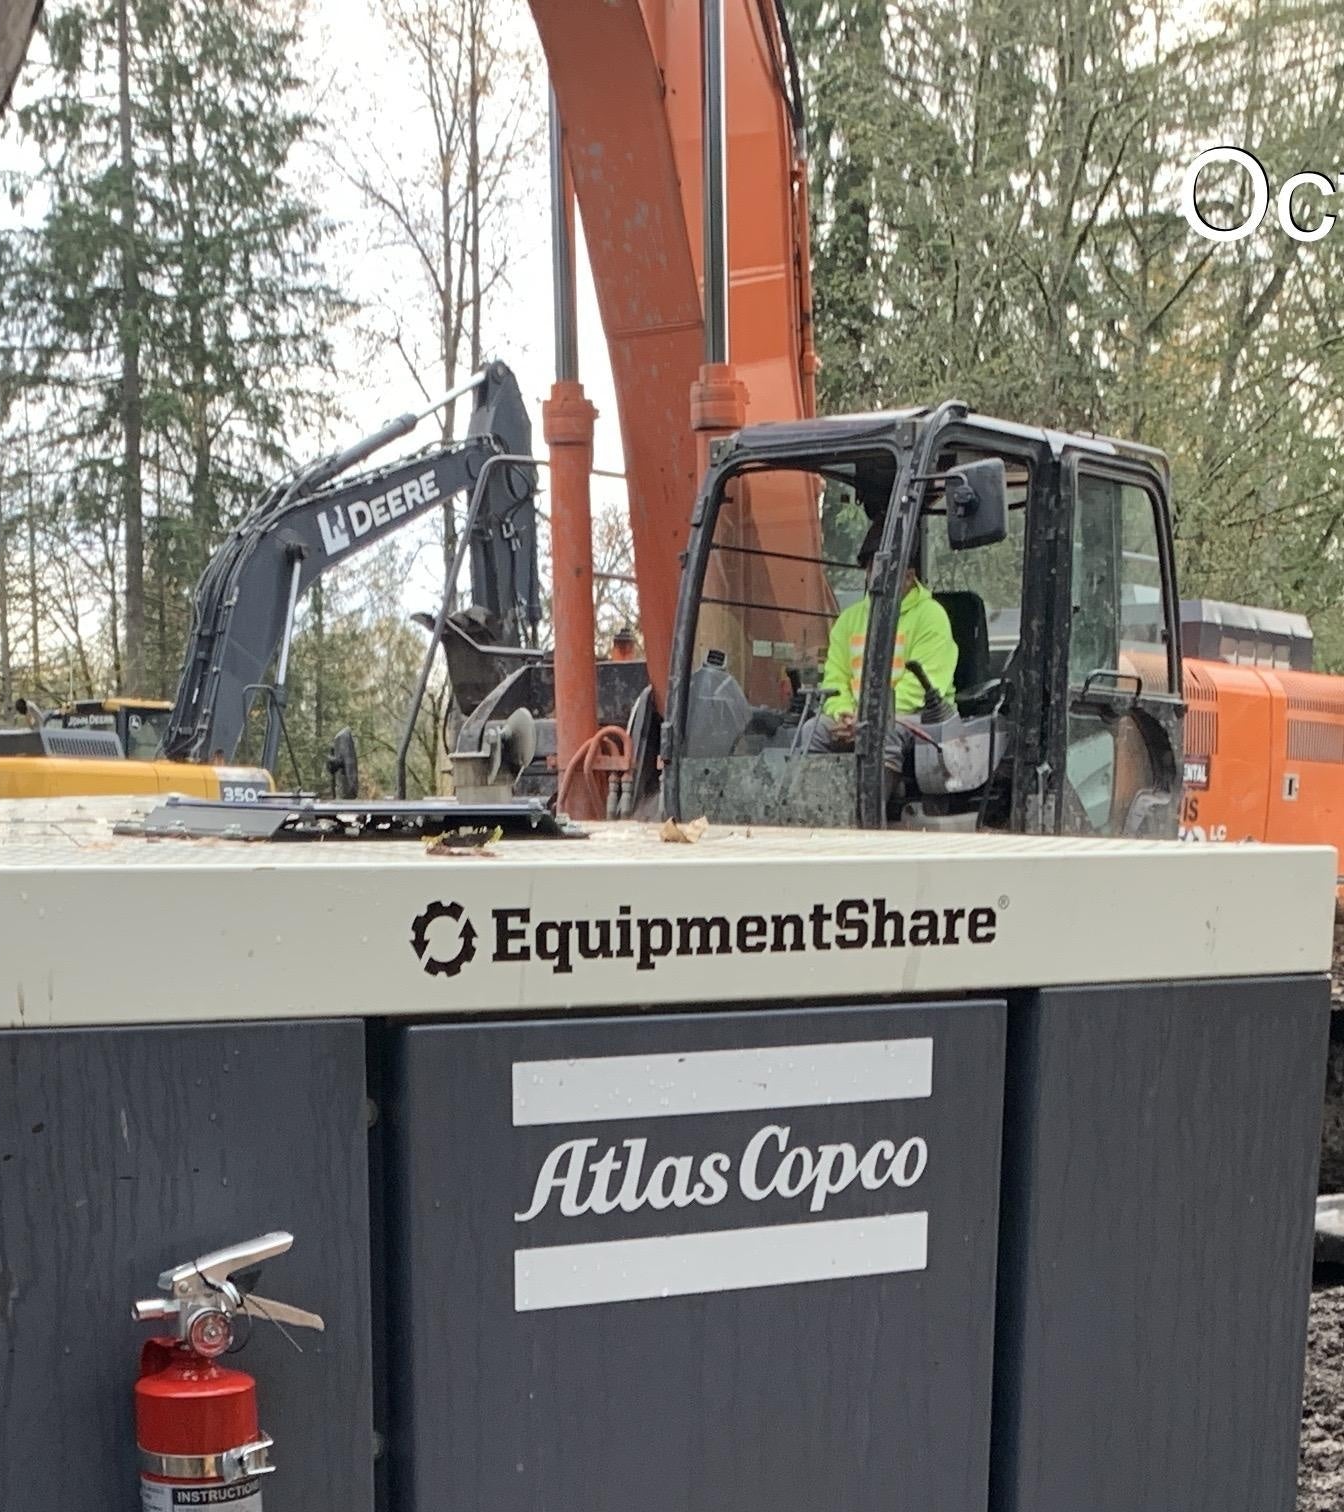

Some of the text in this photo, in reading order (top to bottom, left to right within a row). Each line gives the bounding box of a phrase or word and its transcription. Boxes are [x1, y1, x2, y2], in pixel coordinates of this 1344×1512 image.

[347, 469, 440, 538] DEERE
[491, 898, 998, 974] EquipmentShare
[513, 1124, 929, 1223] Atlas Copco
